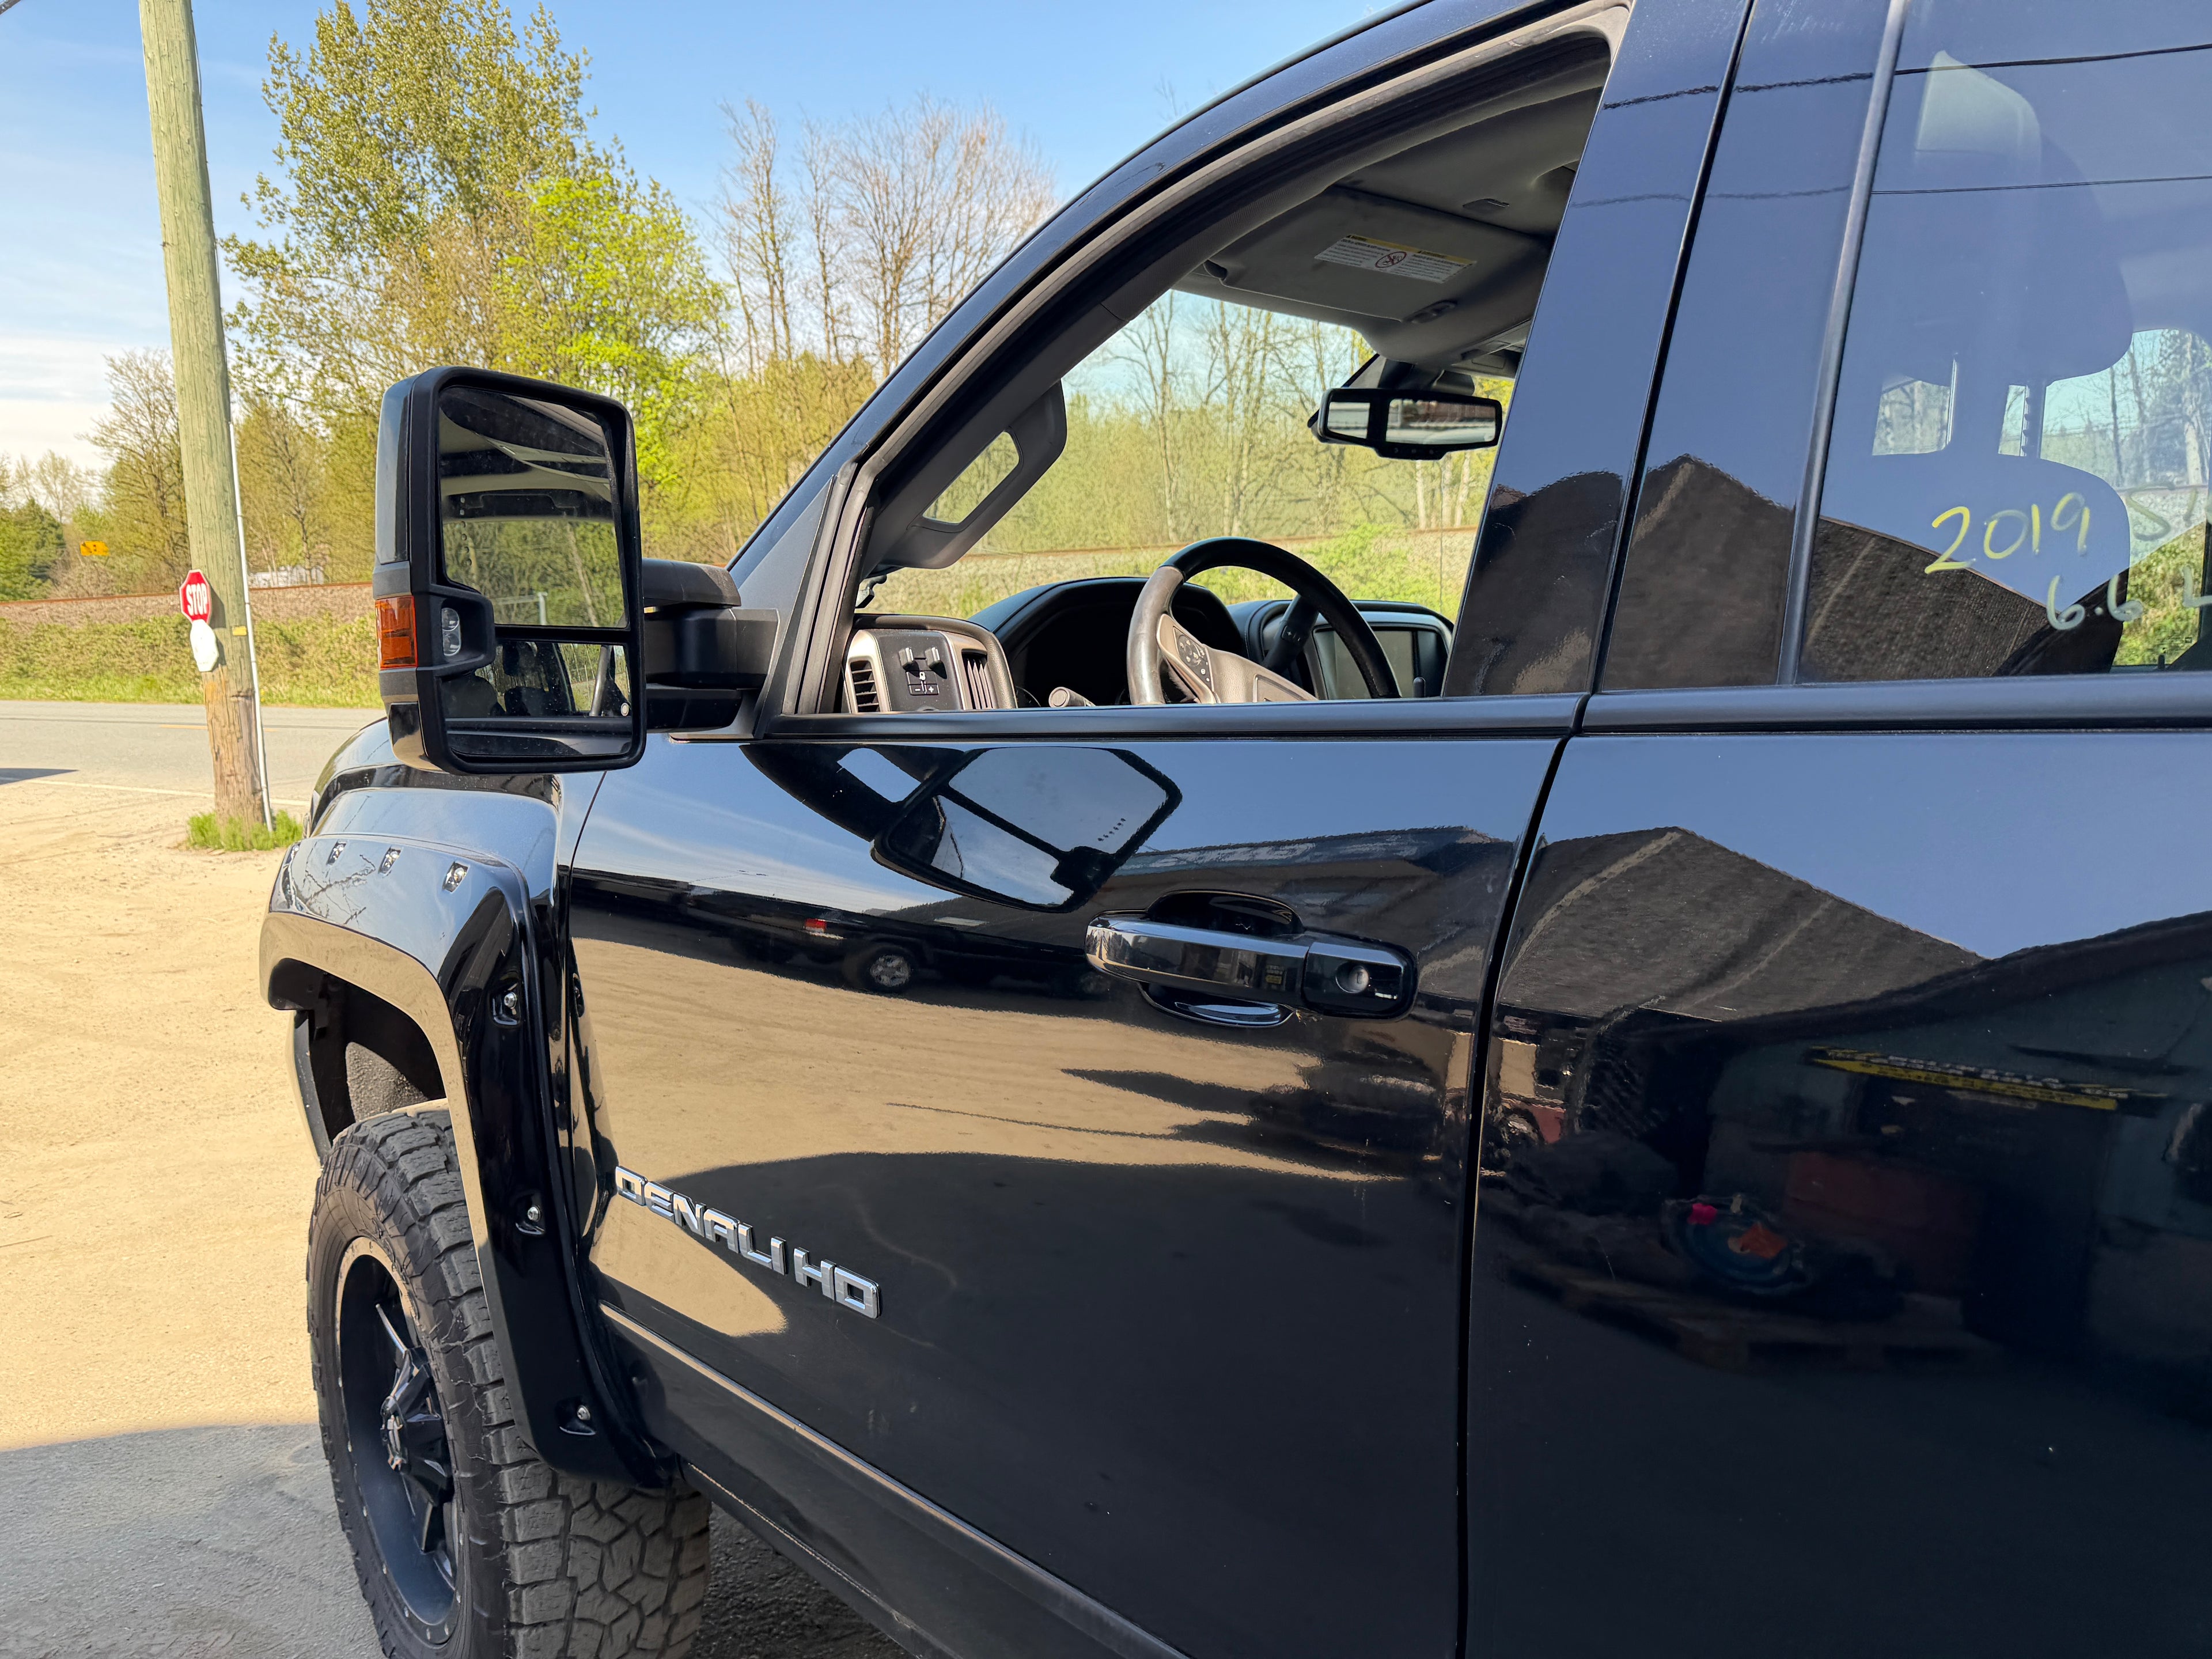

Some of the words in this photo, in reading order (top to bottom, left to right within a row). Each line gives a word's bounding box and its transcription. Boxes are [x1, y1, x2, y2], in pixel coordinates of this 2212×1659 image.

[1924, 491, 2090, 574] 2019
[185, 582, 208, 616] STOP
[2046, 574, 2144, 631] 6.6
[615, 1165, 787, 1276] DENALI
[793, 1246, 882, 1320] HD
